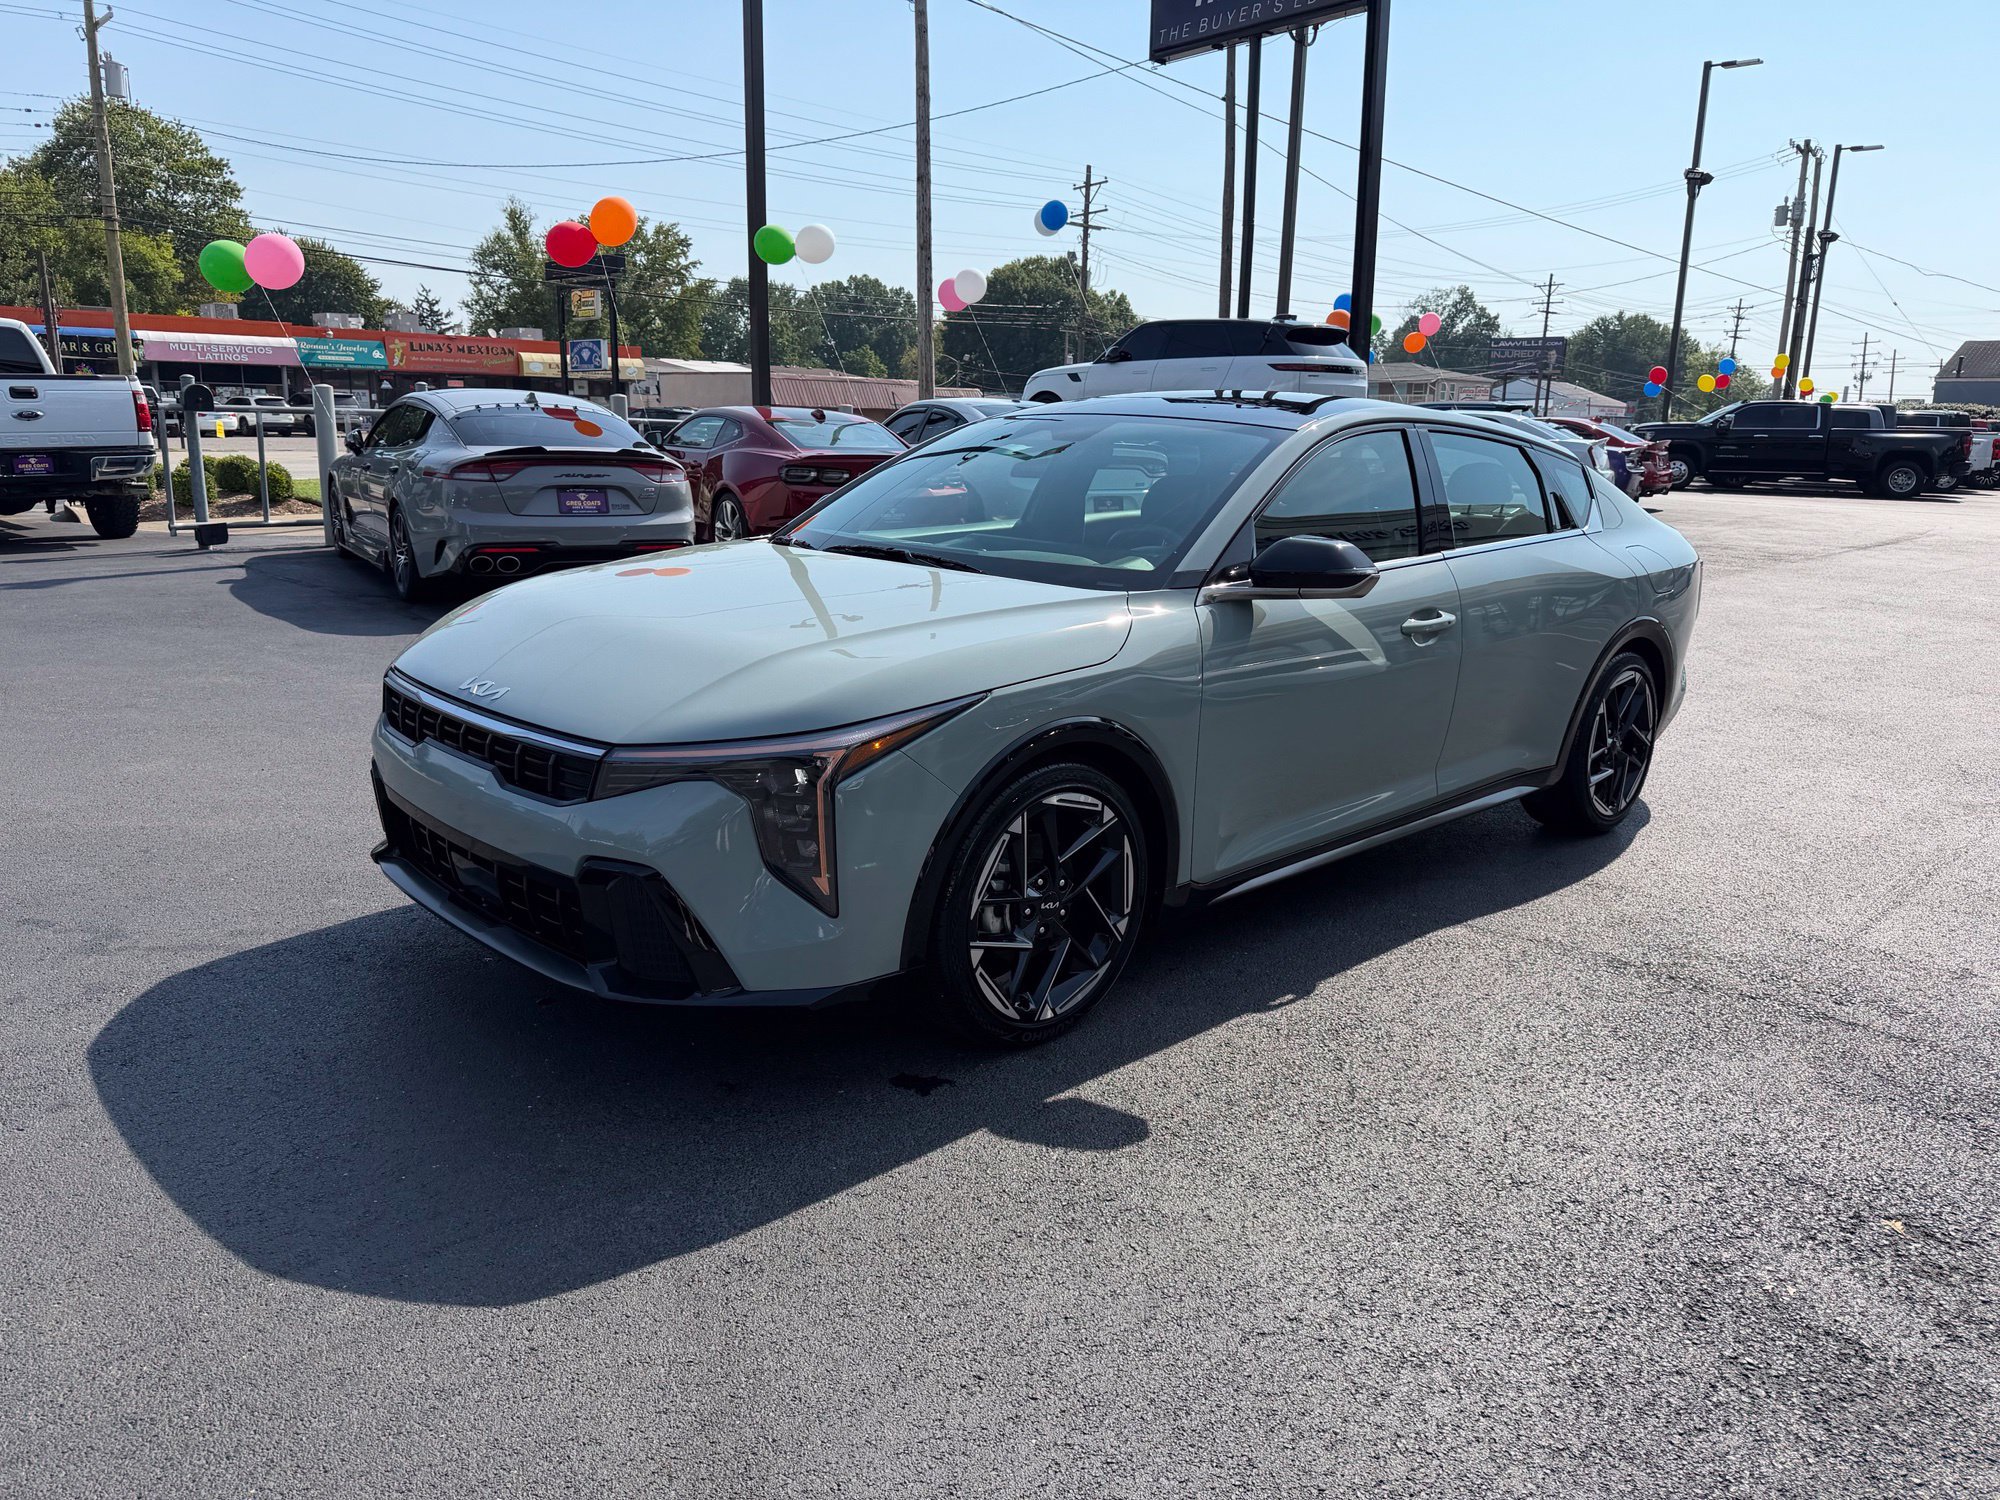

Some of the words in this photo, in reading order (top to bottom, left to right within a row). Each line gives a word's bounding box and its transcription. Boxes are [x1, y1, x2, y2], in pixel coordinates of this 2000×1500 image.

[1159, 22, 1192, 44] THE
[1199, 0, 1283, 33] BUYER'S
[59, 342, 78, 352] AR
[82, 343, 90, 353] &
[94, 341, 117, 353] GRI
[169, 342, 273, 355] MULTI-SERVICIOS
[457, 345, 515, 357] MEXICAN
[197, 352, 249, 362] LATINOS
[1491, 349, 1542, 358] INJURED?
